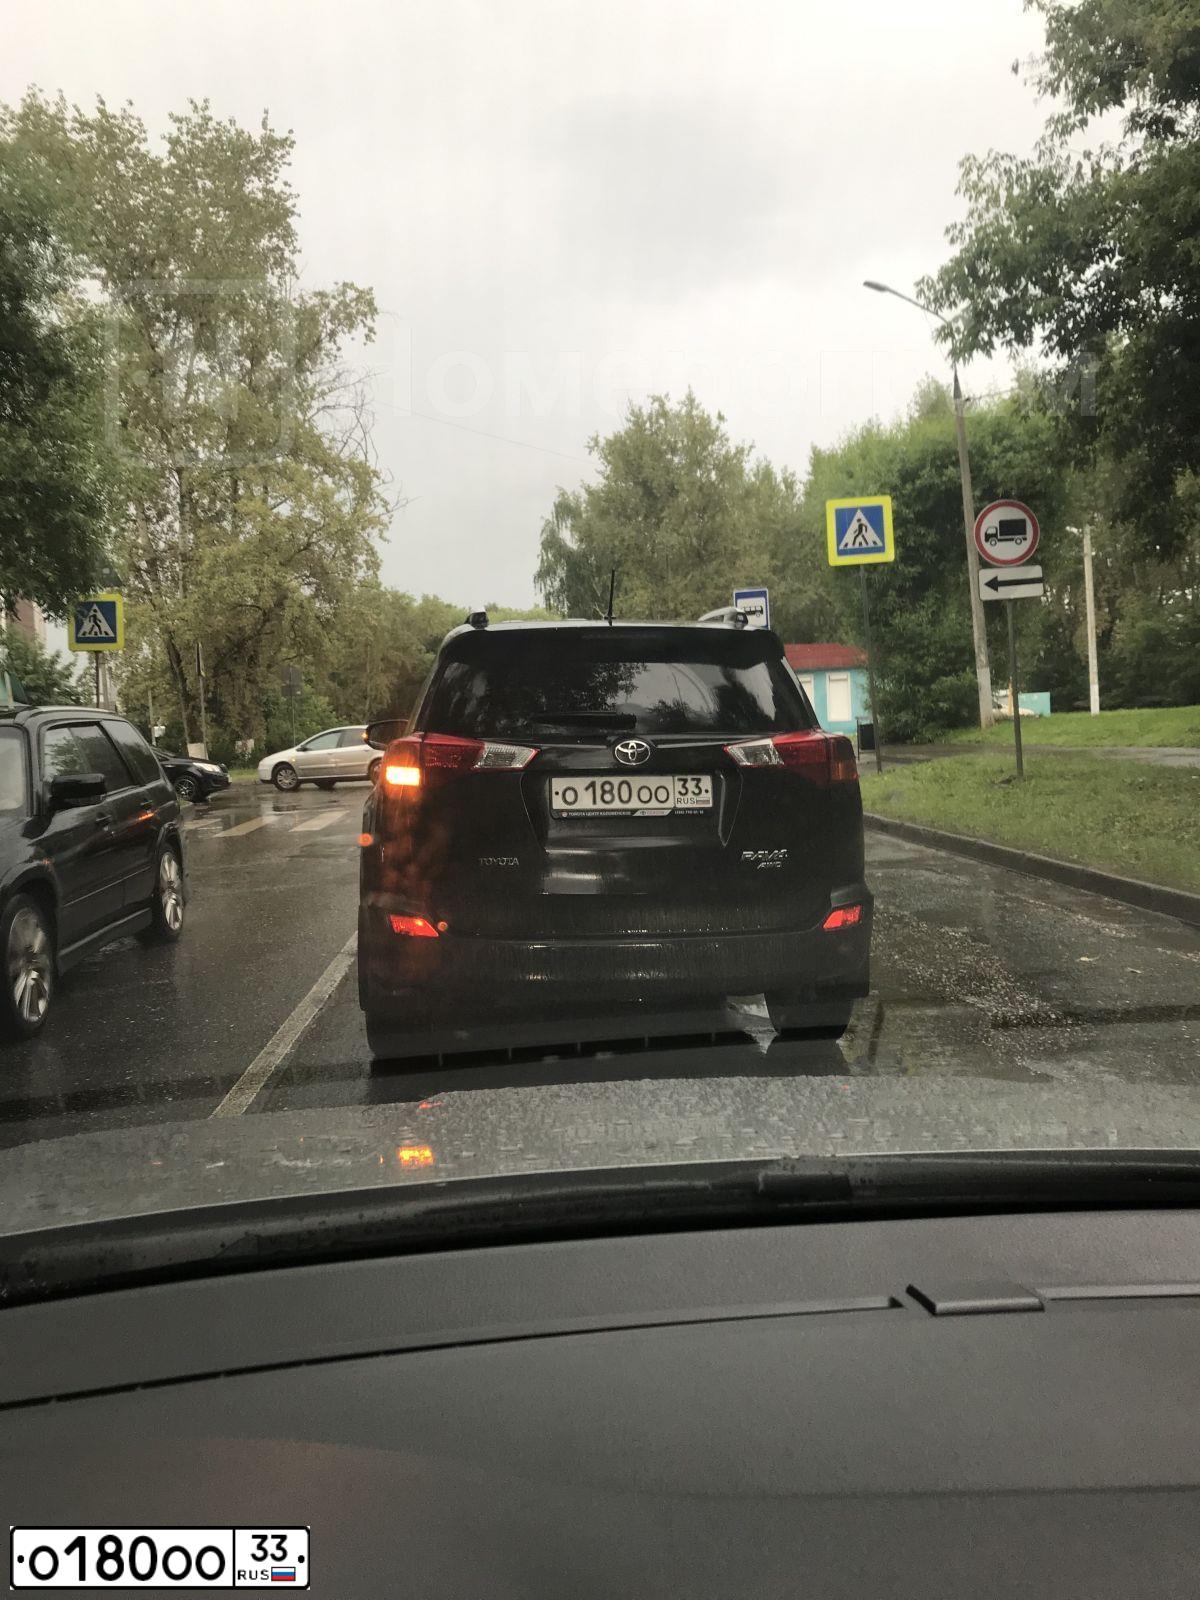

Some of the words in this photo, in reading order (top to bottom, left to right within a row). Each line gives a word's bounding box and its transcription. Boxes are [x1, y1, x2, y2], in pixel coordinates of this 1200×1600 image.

[677, 778, 702, 796] 33
[676, 797, 695, 805] RUS
[478, 857, 520, 866] TOYOTA
